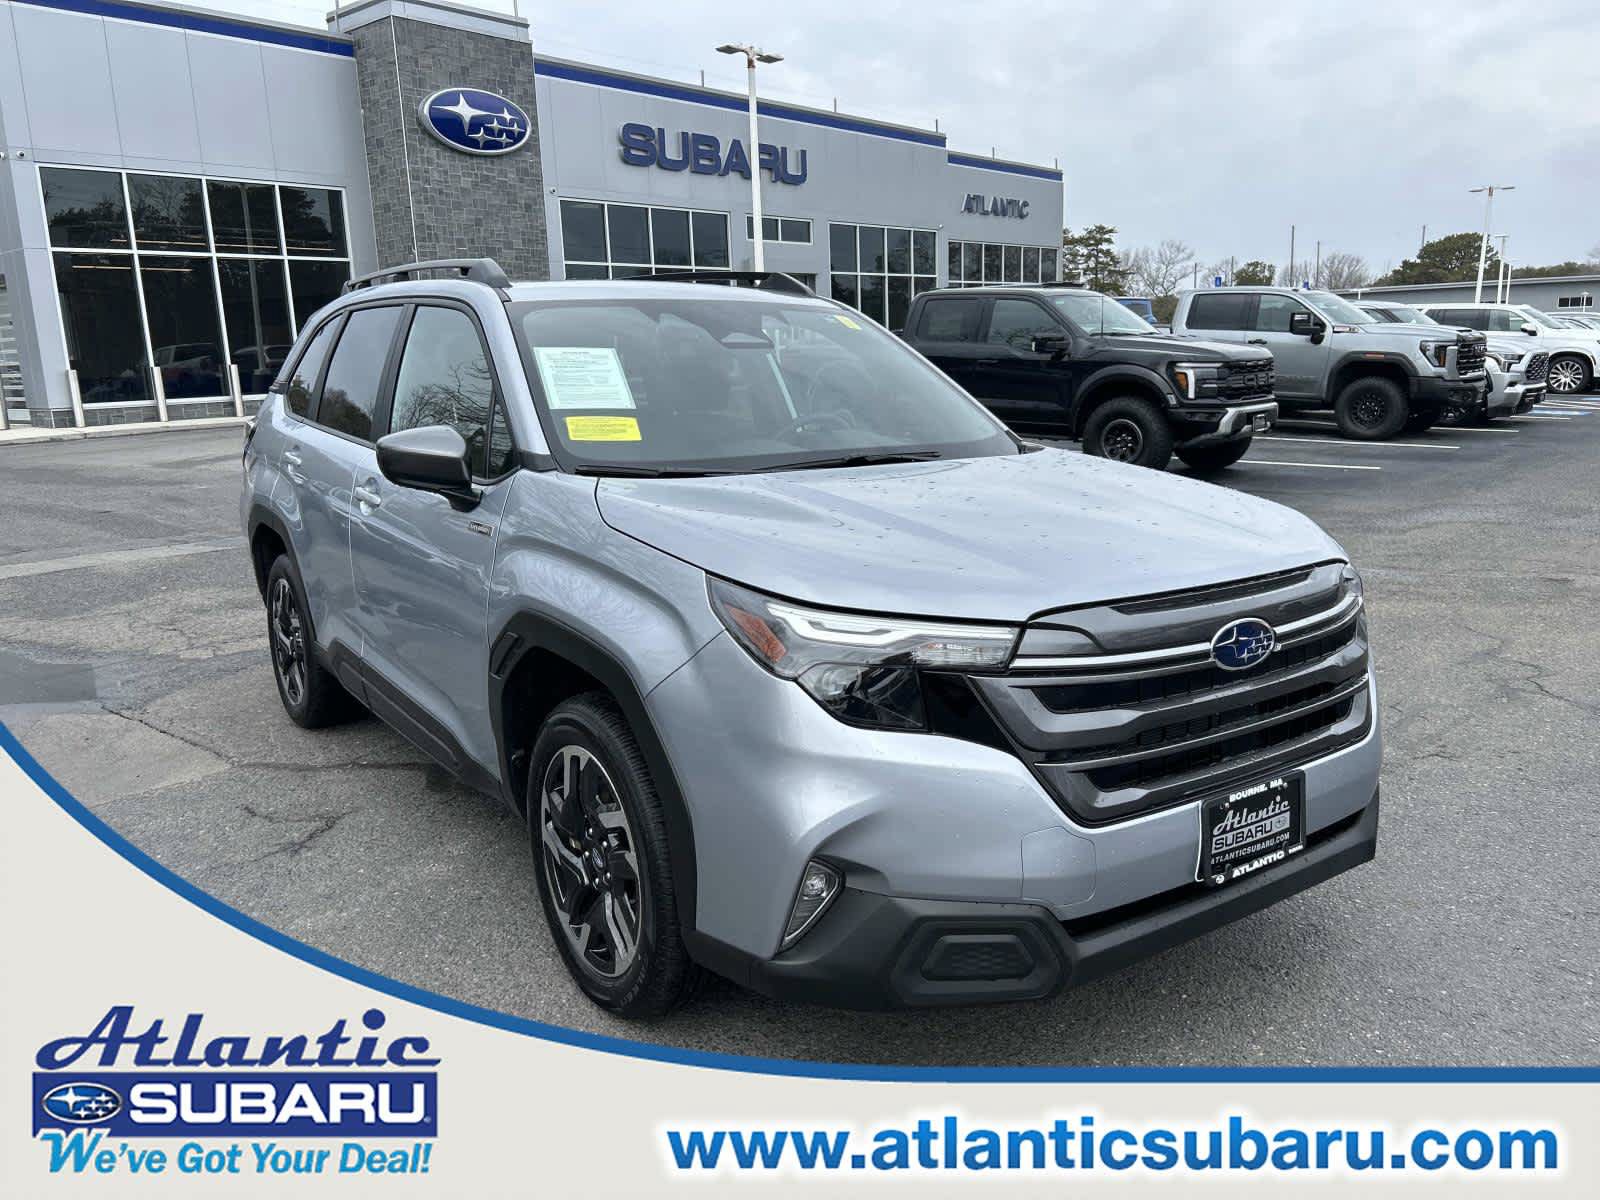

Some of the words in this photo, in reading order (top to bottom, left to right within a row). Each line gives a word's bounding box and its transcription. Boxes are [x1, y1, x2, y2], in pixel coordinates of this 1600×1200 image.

[620, 122, 807, 186] SUBARU
[960, 193, 1030, 220] ATLANTIC
[1270, 778, 1283, 789] MA
[1213, 795, 1291, 836] Atlantic
[1210, 832, 1290, 865] ATLANTICSUBARU.COM
[1213, 820, 1273, 850] SUBARU
[1232, 851, 1285, 878] ATLANTIC
